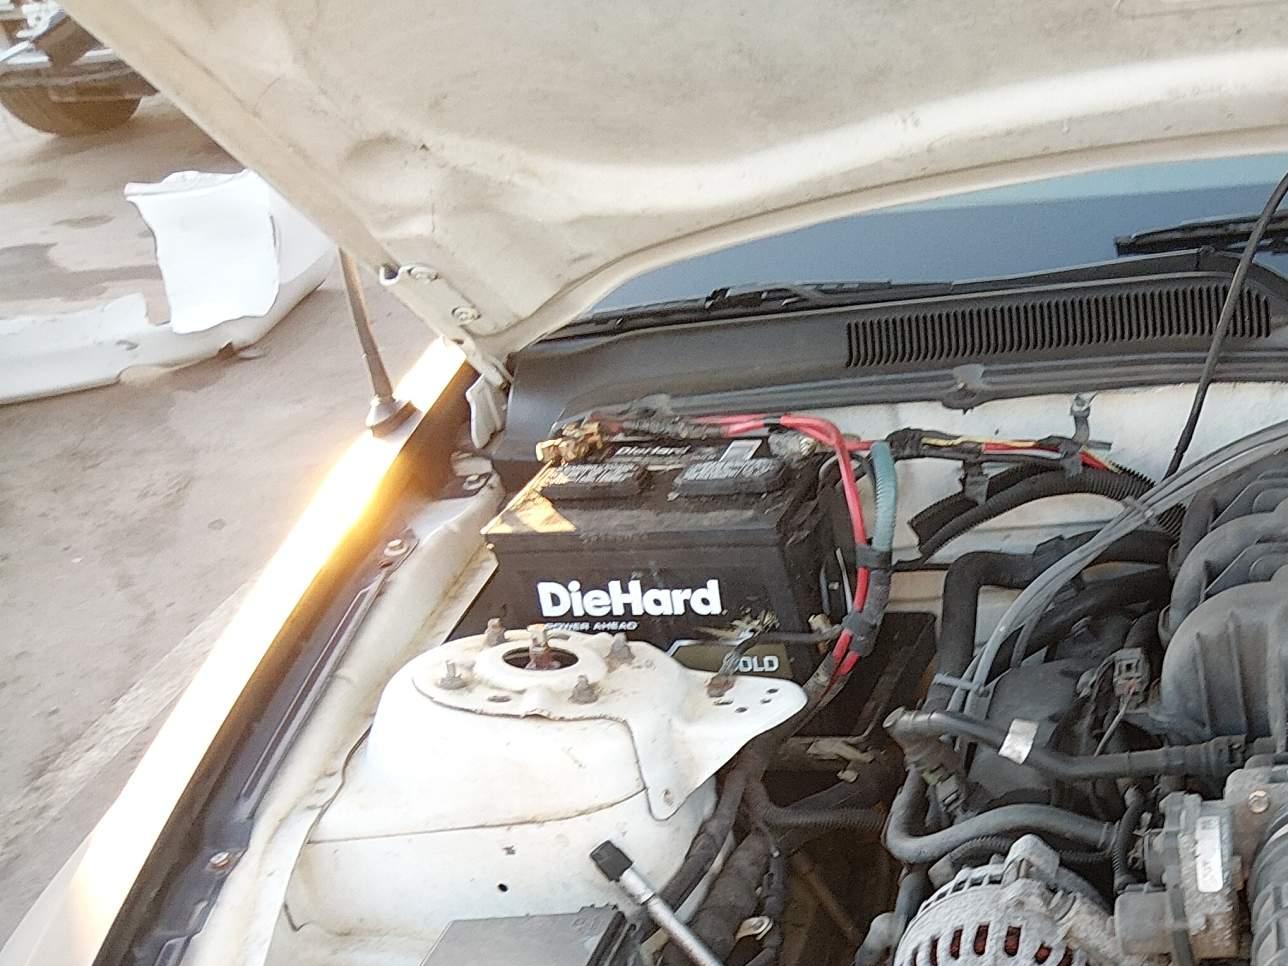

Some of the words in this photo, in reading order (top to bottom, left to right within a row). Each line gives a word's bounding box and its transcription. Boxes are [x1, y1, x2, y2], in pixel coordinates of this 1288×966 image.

[537, 579, 722, 617] DieHard
[592, 621, 638, 631] AHEAD
[736, 655, 779, 672] OLD
